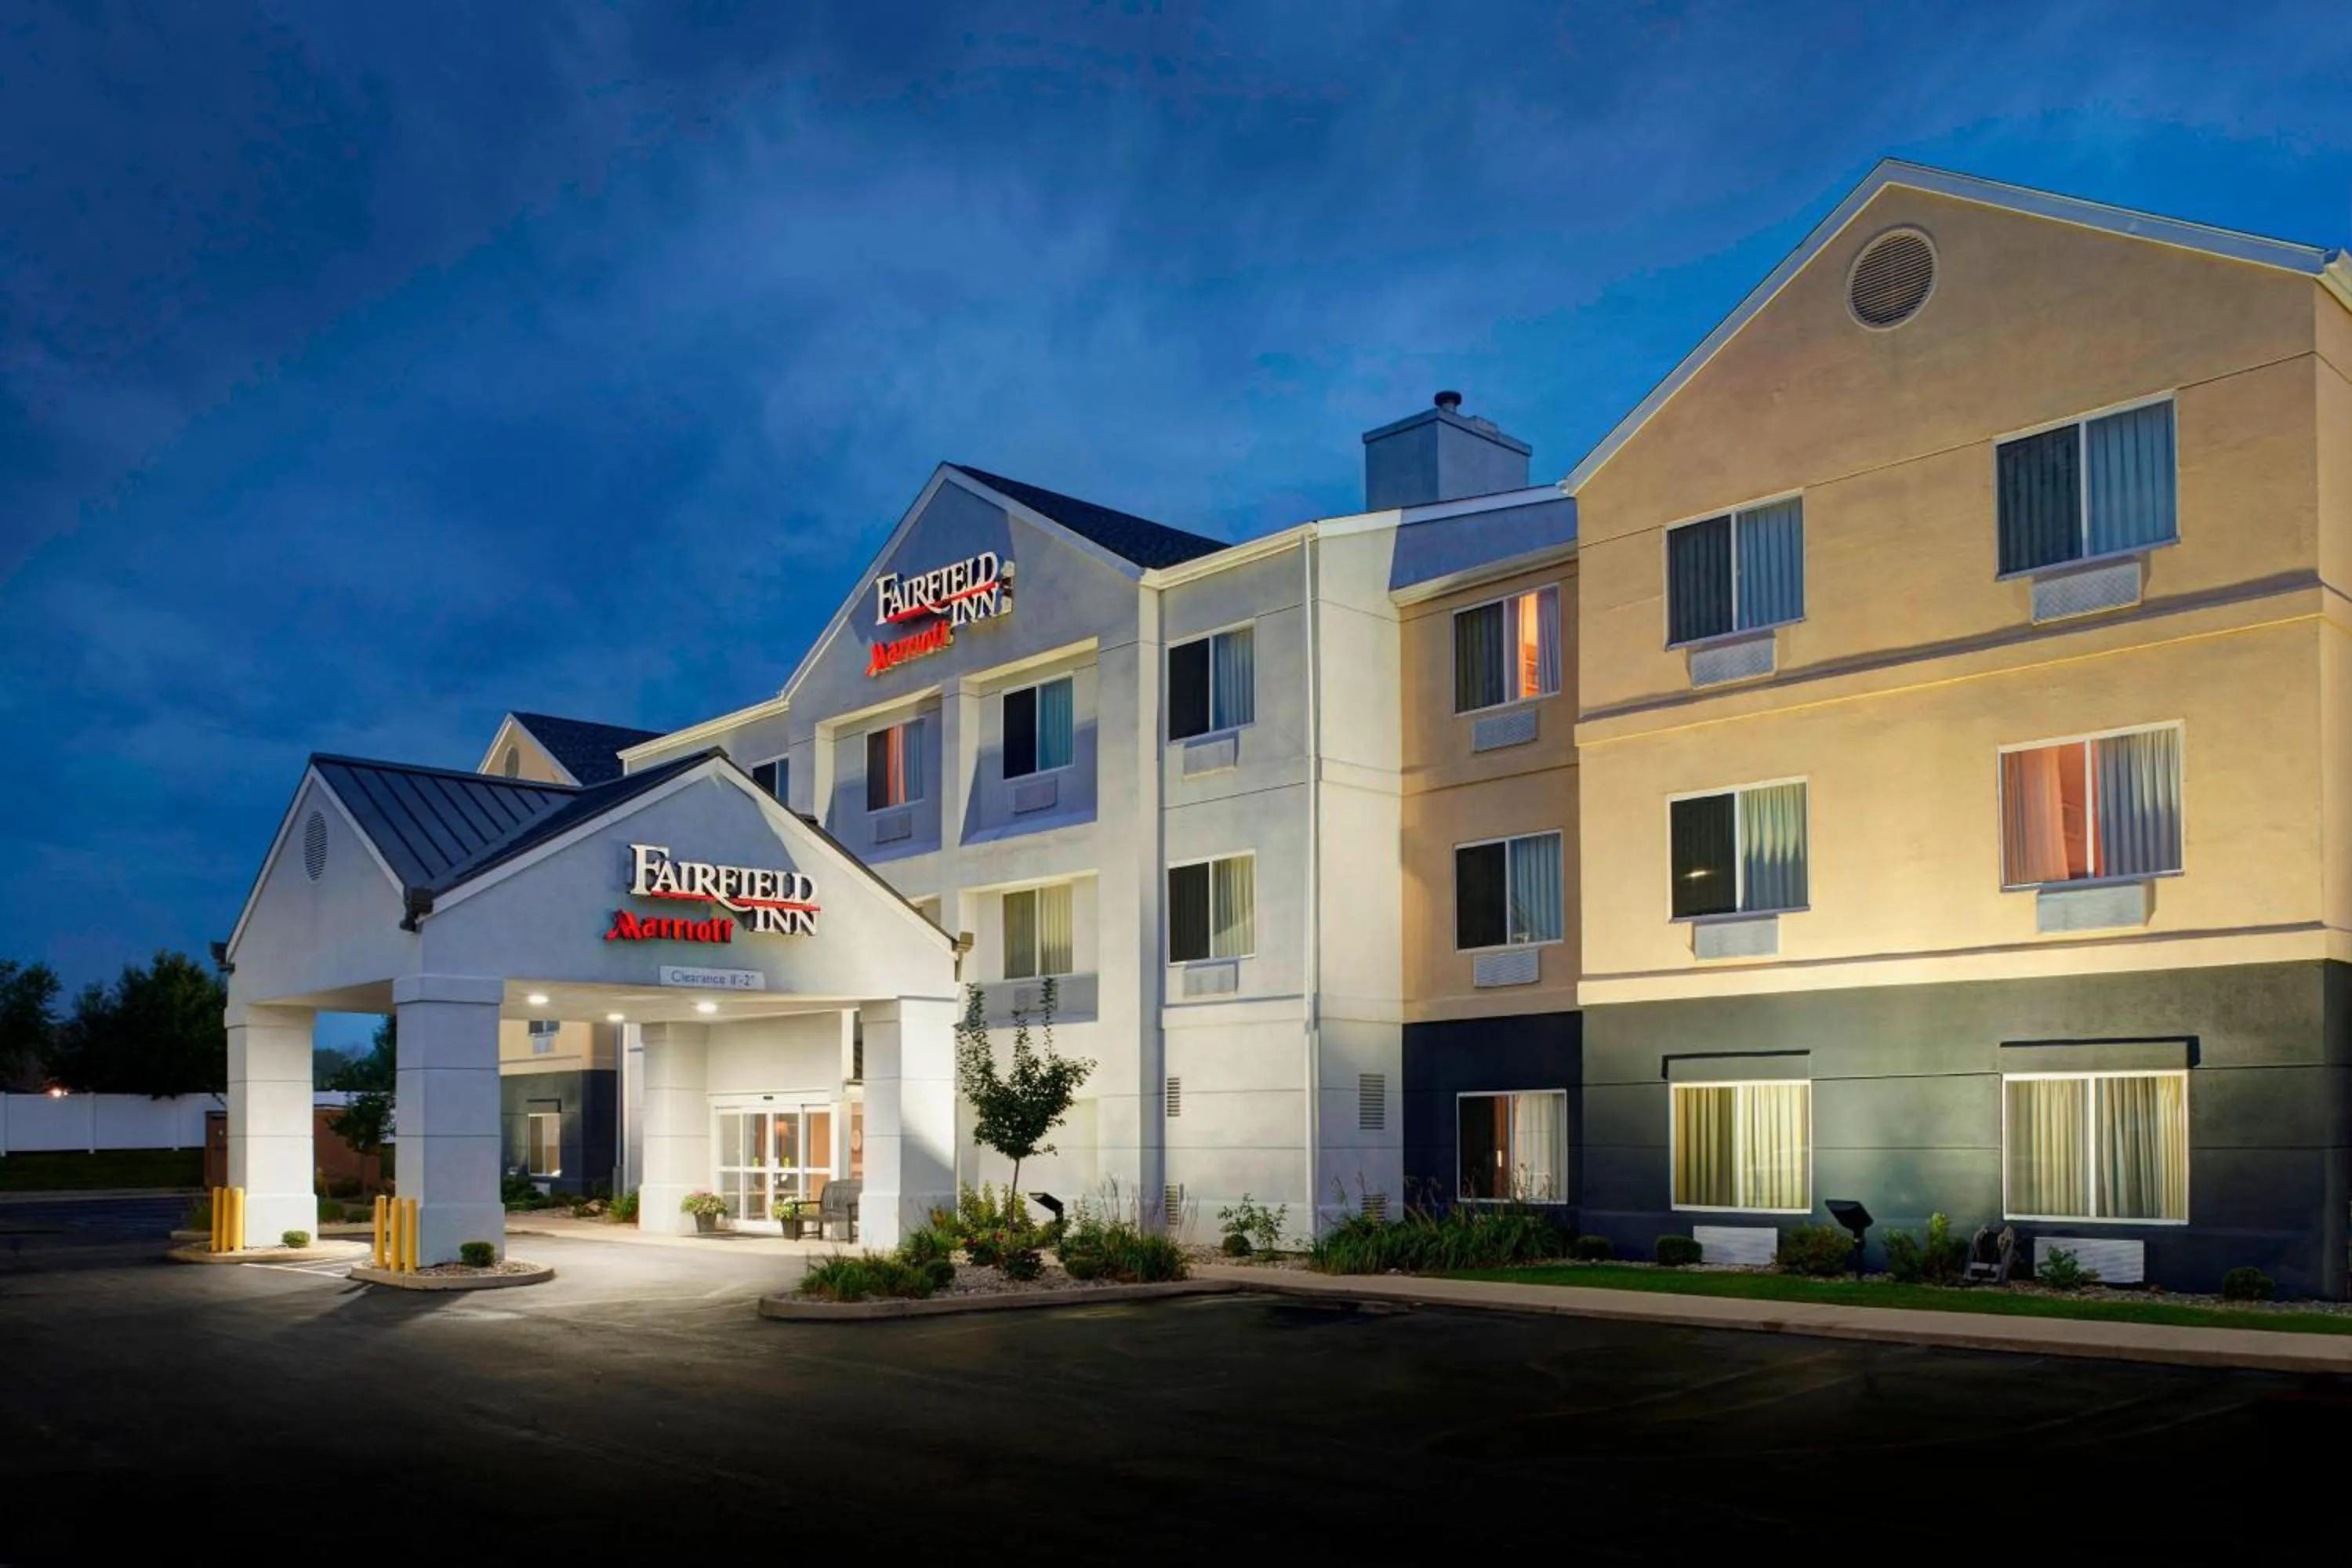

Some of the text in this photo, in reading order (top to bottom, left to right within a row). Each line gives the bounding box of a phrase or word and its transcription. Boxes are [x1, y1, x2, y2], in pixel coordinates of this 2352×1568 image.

[876, 552, 998, 626] FAIRFIELD
[951, 586, 998, 626] INN
[866, 619, 949, 677] Marriott
[630, 844, 818, 911] FAIRFIELD
[606, 909, 734, 943] Marriott
[750, 907, 818, 935] INN
[671, 970, 725, 985] Clearance
